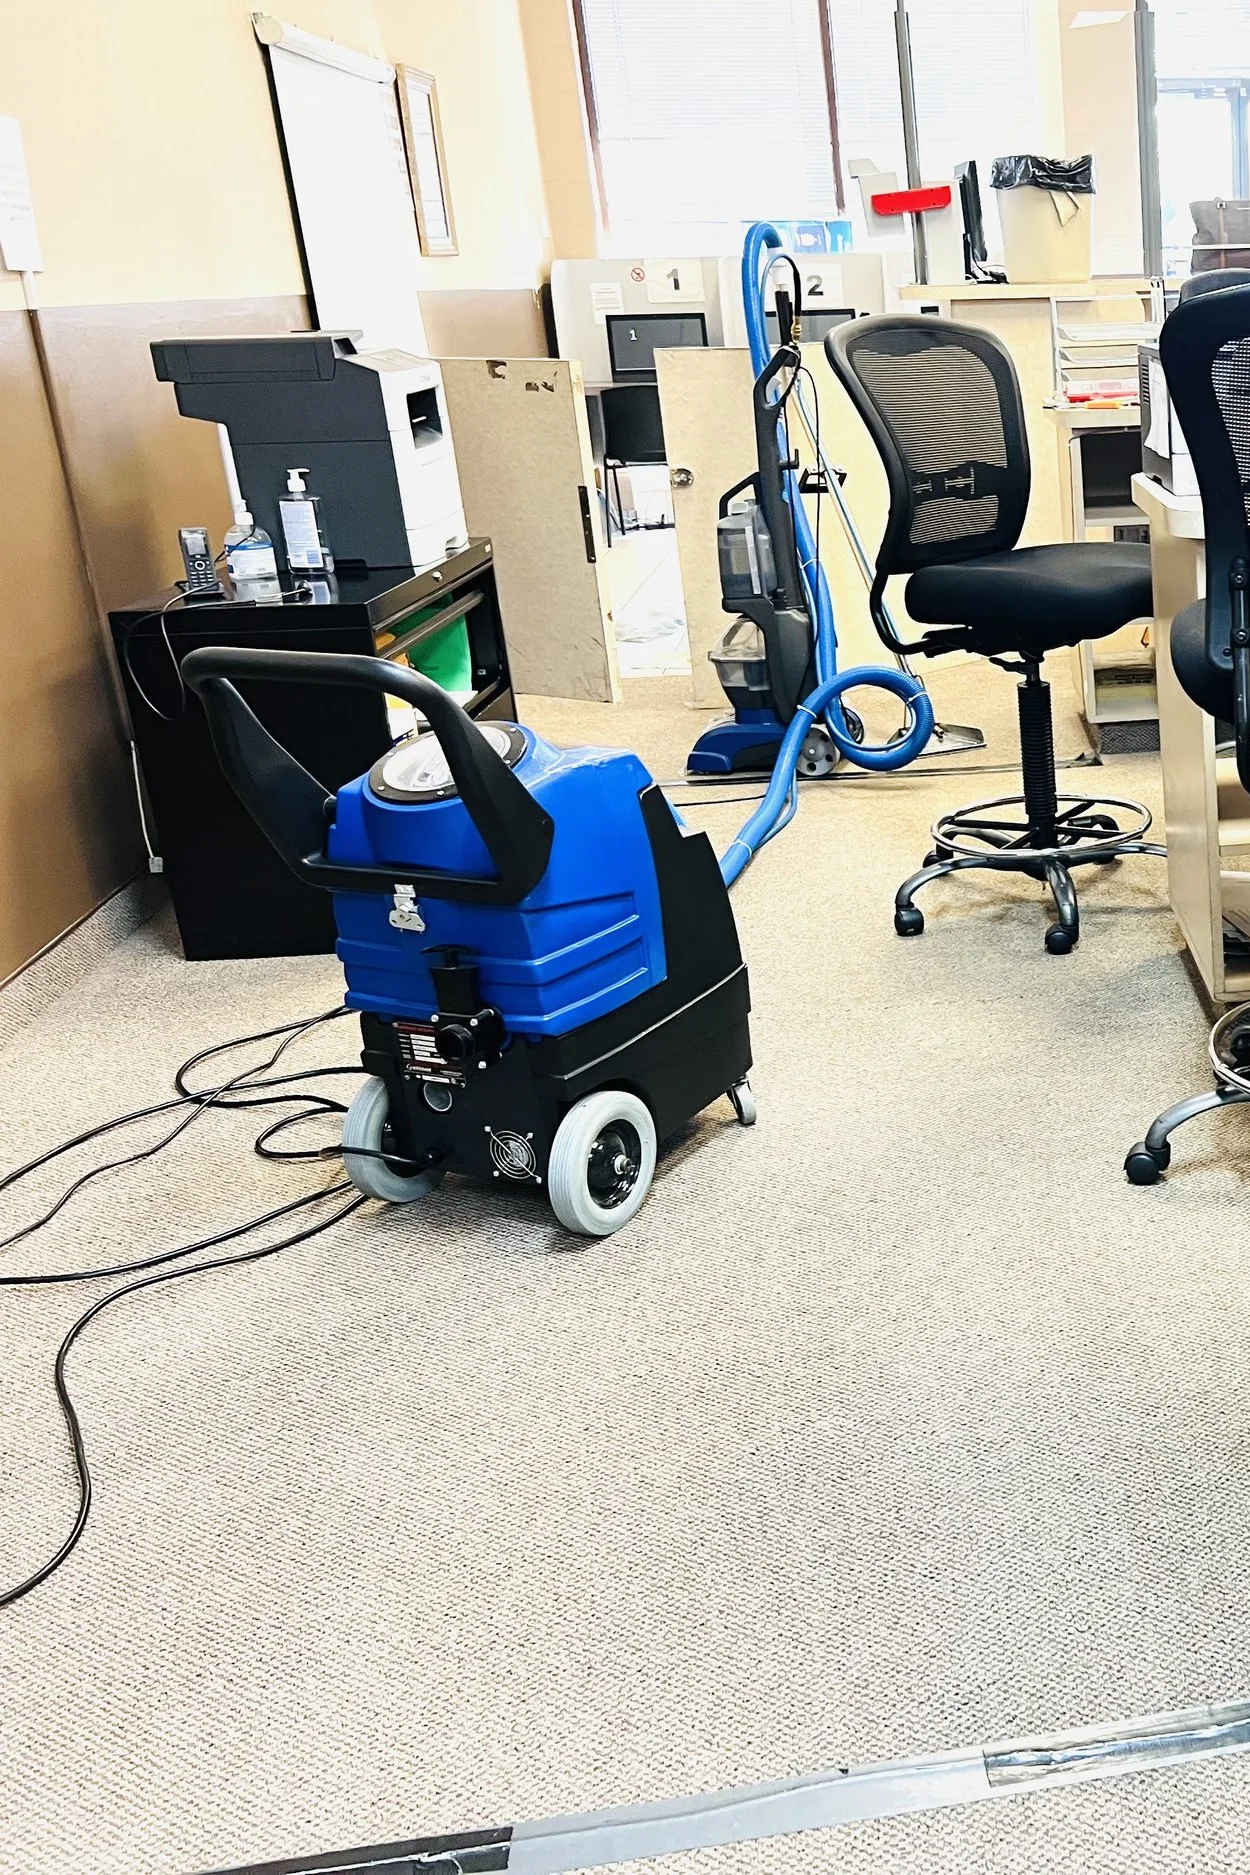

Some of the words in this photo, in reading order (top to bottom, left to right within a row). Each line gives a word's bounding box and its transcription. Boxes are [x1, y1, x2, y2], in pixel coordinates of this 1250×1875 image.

[666, 268, 681, 291] 1
[806, 274, 824, 296] 2
[629, 328, 638, 341] 1
